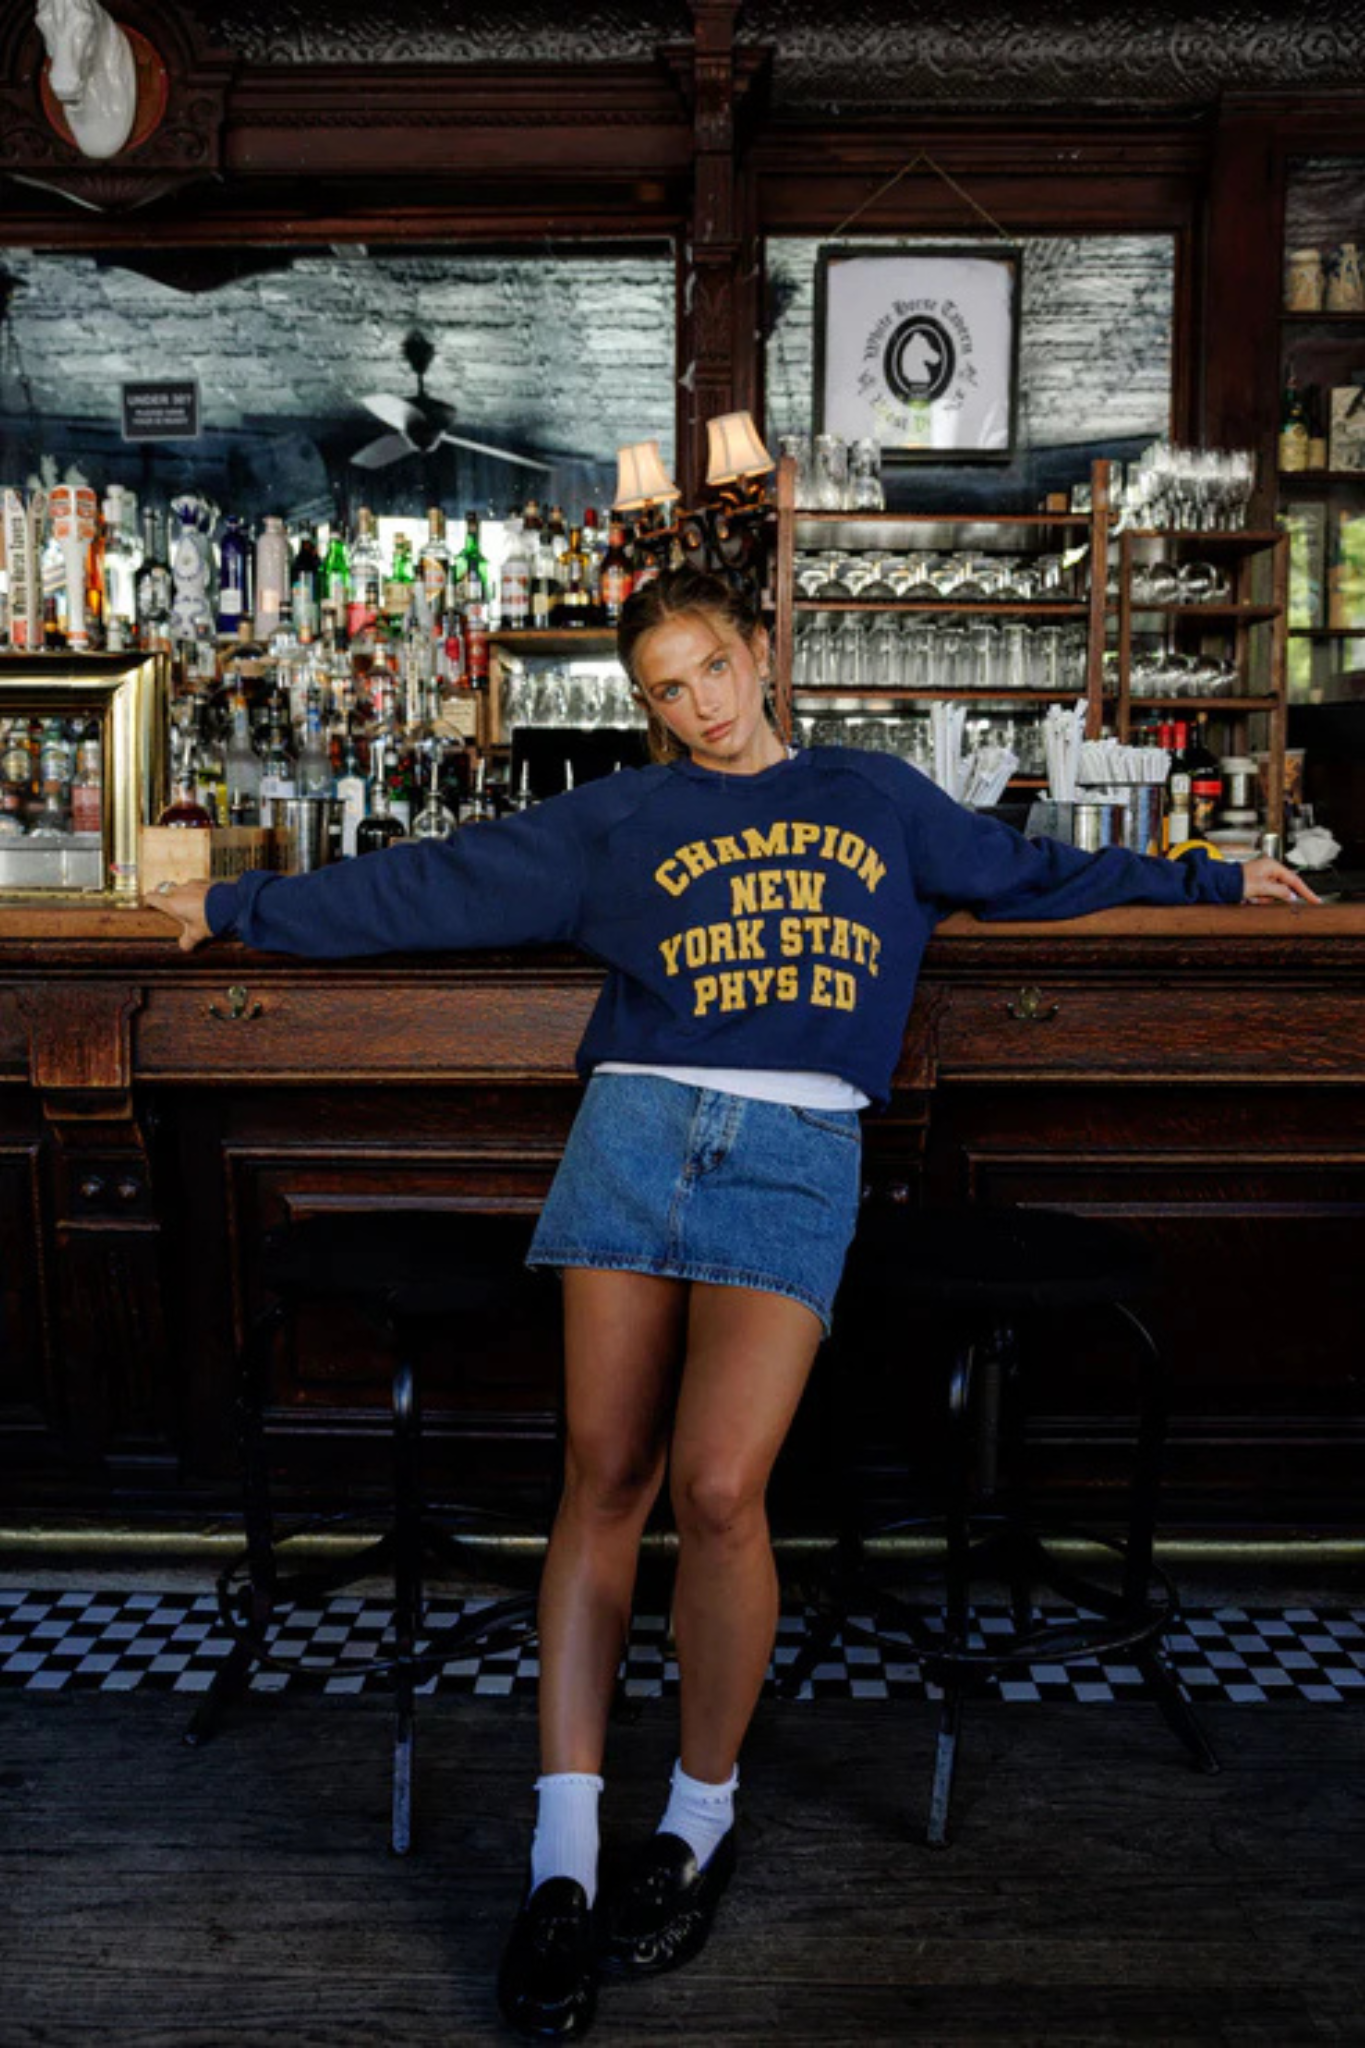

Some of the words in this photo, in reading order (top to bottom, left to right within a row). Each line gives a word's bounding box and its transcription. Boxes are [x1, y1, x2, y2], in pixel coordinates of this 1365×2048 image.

[654, 821, 888, 897] CHAMPION
[730, 869, 826, 916] NEW
[658, 918, 766, 976] YORK
[780, 916, 881, 978] STATE
[693, 964, 799, 1017] PHYS
[810, 964, 856, 1012] ED
